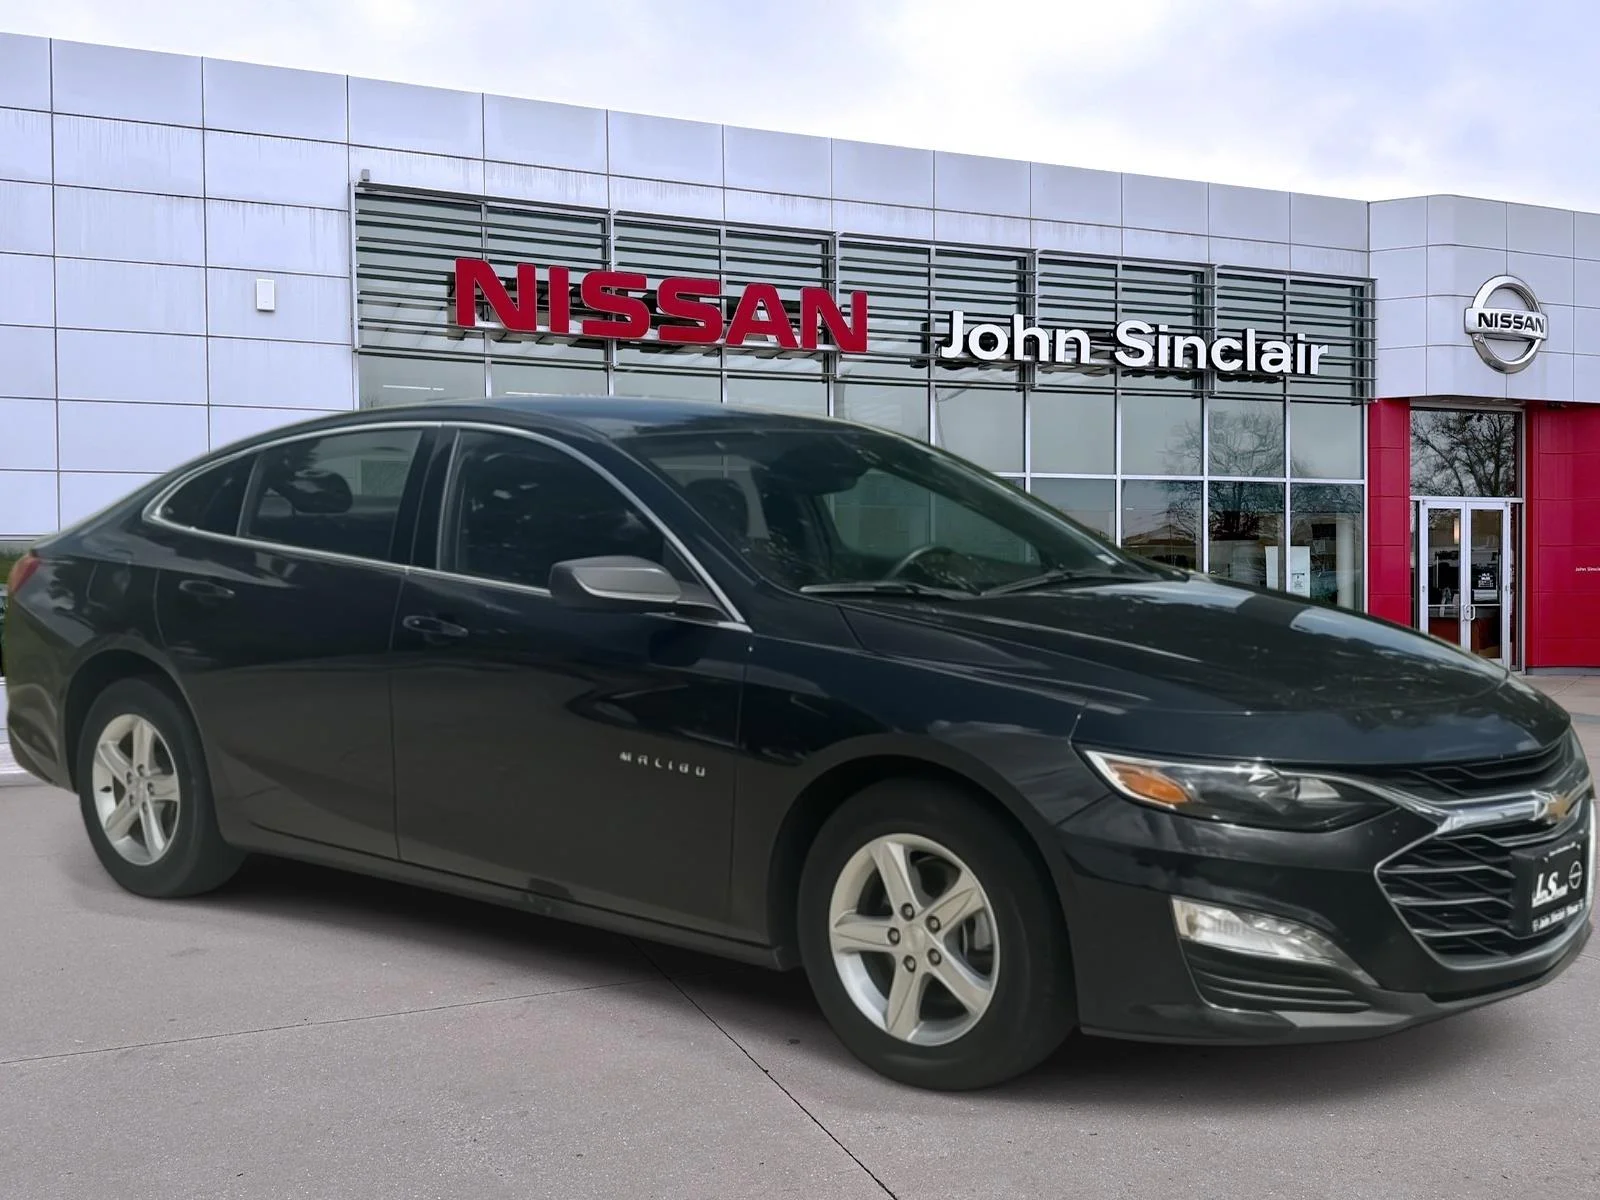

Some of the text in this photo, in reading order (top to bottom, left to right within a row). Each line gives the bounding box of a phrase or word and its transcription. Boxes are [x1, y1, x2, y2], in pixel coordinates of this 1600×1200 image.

[455, 257, 868, 353] NISSAN
[1478, 312, 1545, 333] NISSAN
[940, 309, 1329, 375] John Sinclair
[619, 751, 706, 777] MALIBU
